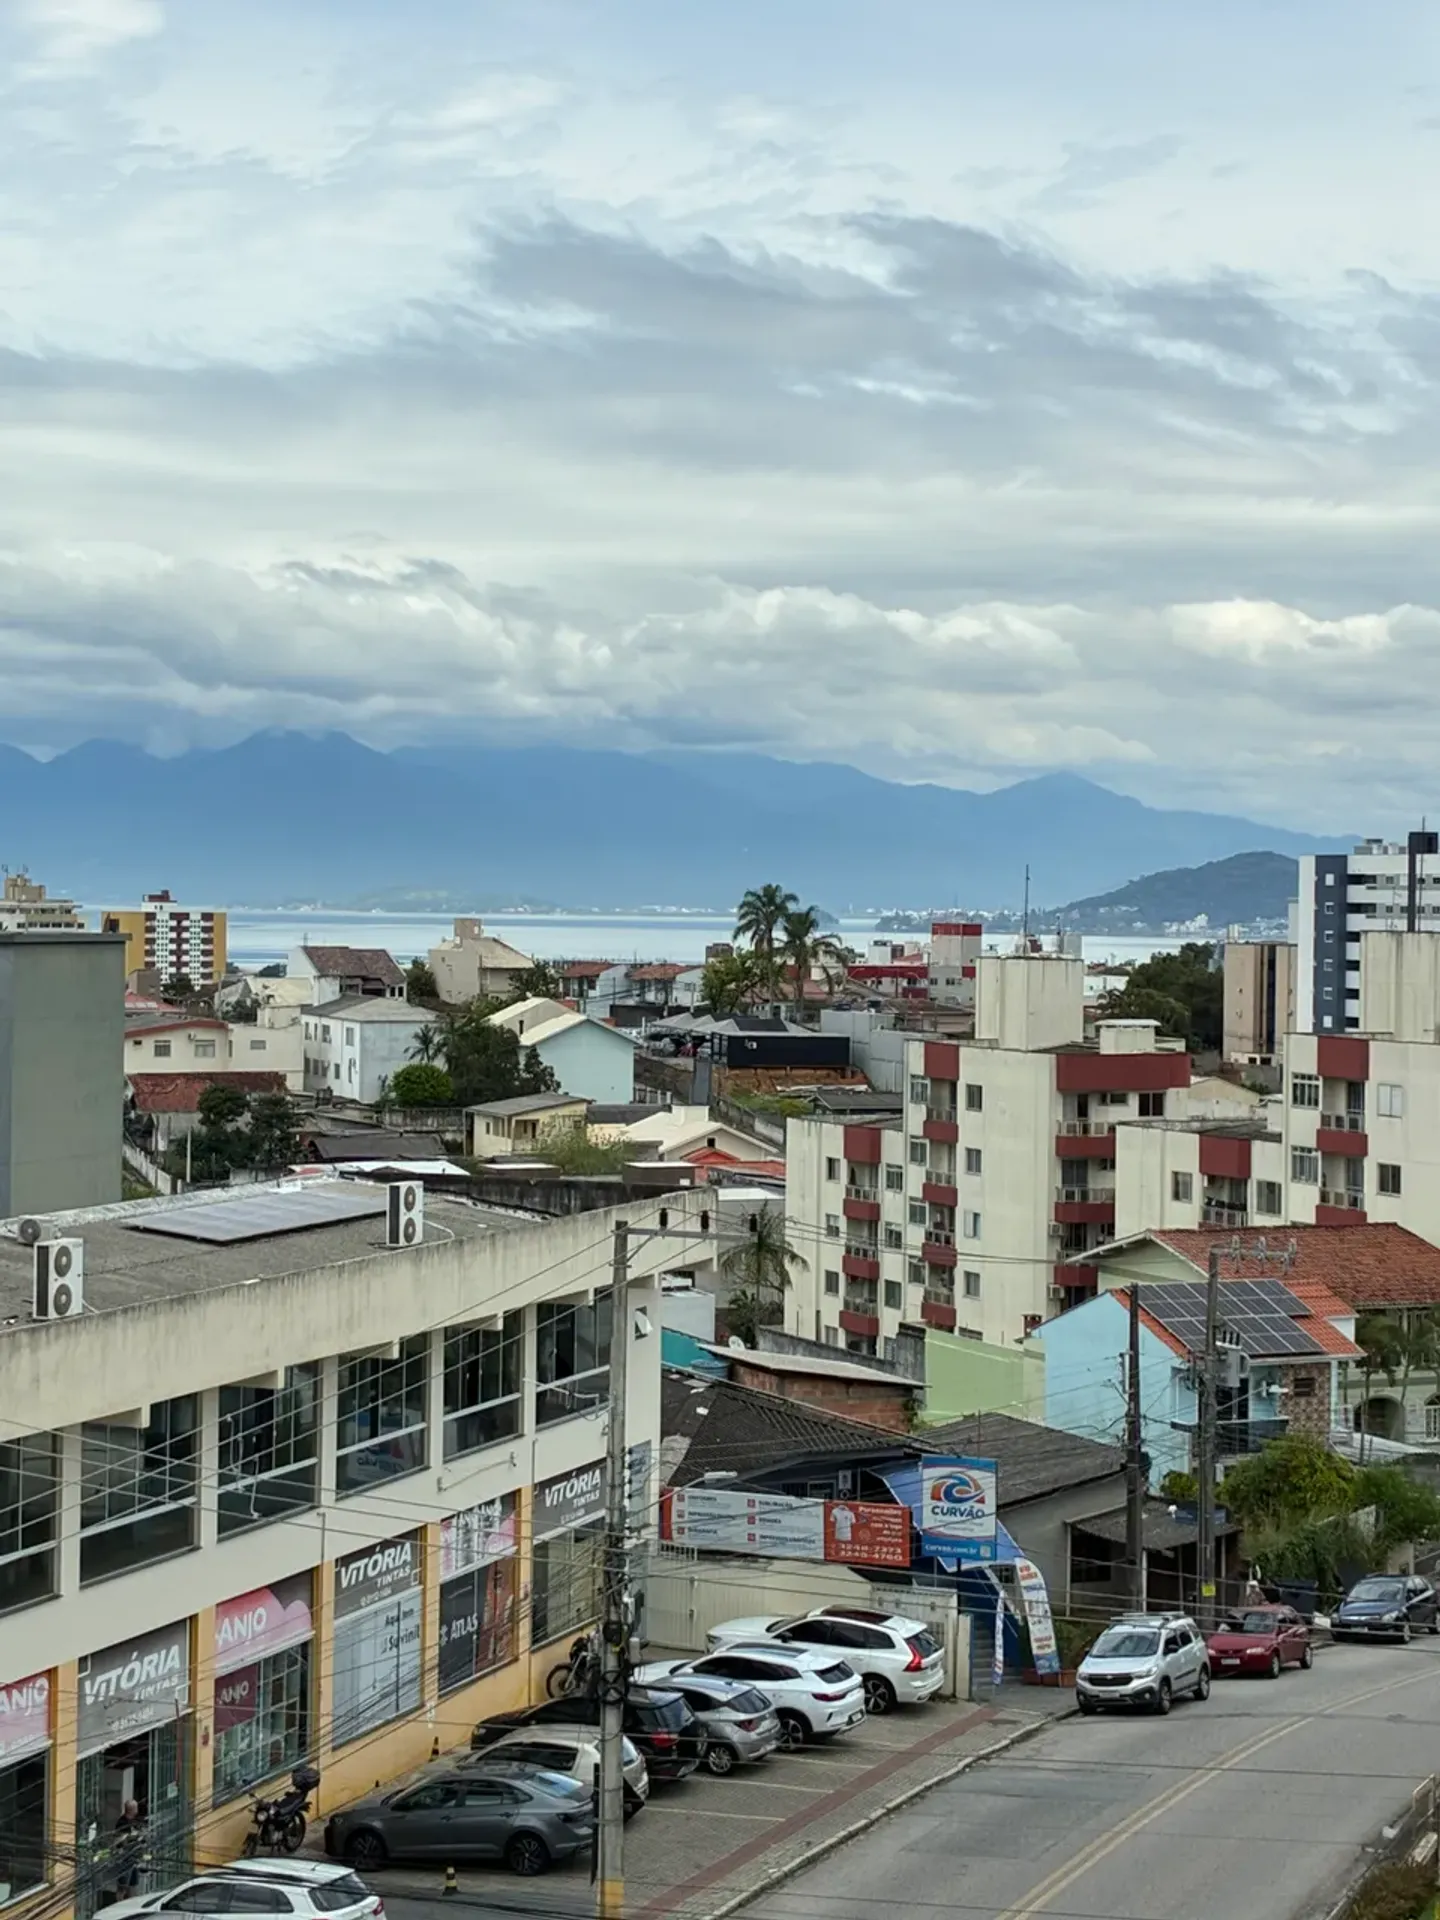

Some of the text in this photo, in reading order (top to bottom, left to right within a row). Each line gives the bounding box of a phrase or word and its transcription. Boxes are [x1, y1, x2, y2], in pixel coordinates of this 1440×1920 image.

[545, 1469, 601, 1508] VITÓRIA
[573, 1490, 600, 1508] TINTAS
[932, 1505, 985, 1519] CURVÃO
[341, 1542, 412, 1589] VITÓRIA
[377, 1565, 411, 1588] TINTAS
[218, 1606, 267, 1646] ANJO
[84, 1644, 181, 1706] VITÓRIA
[133, 1674, 179, 1701] TINTAS
